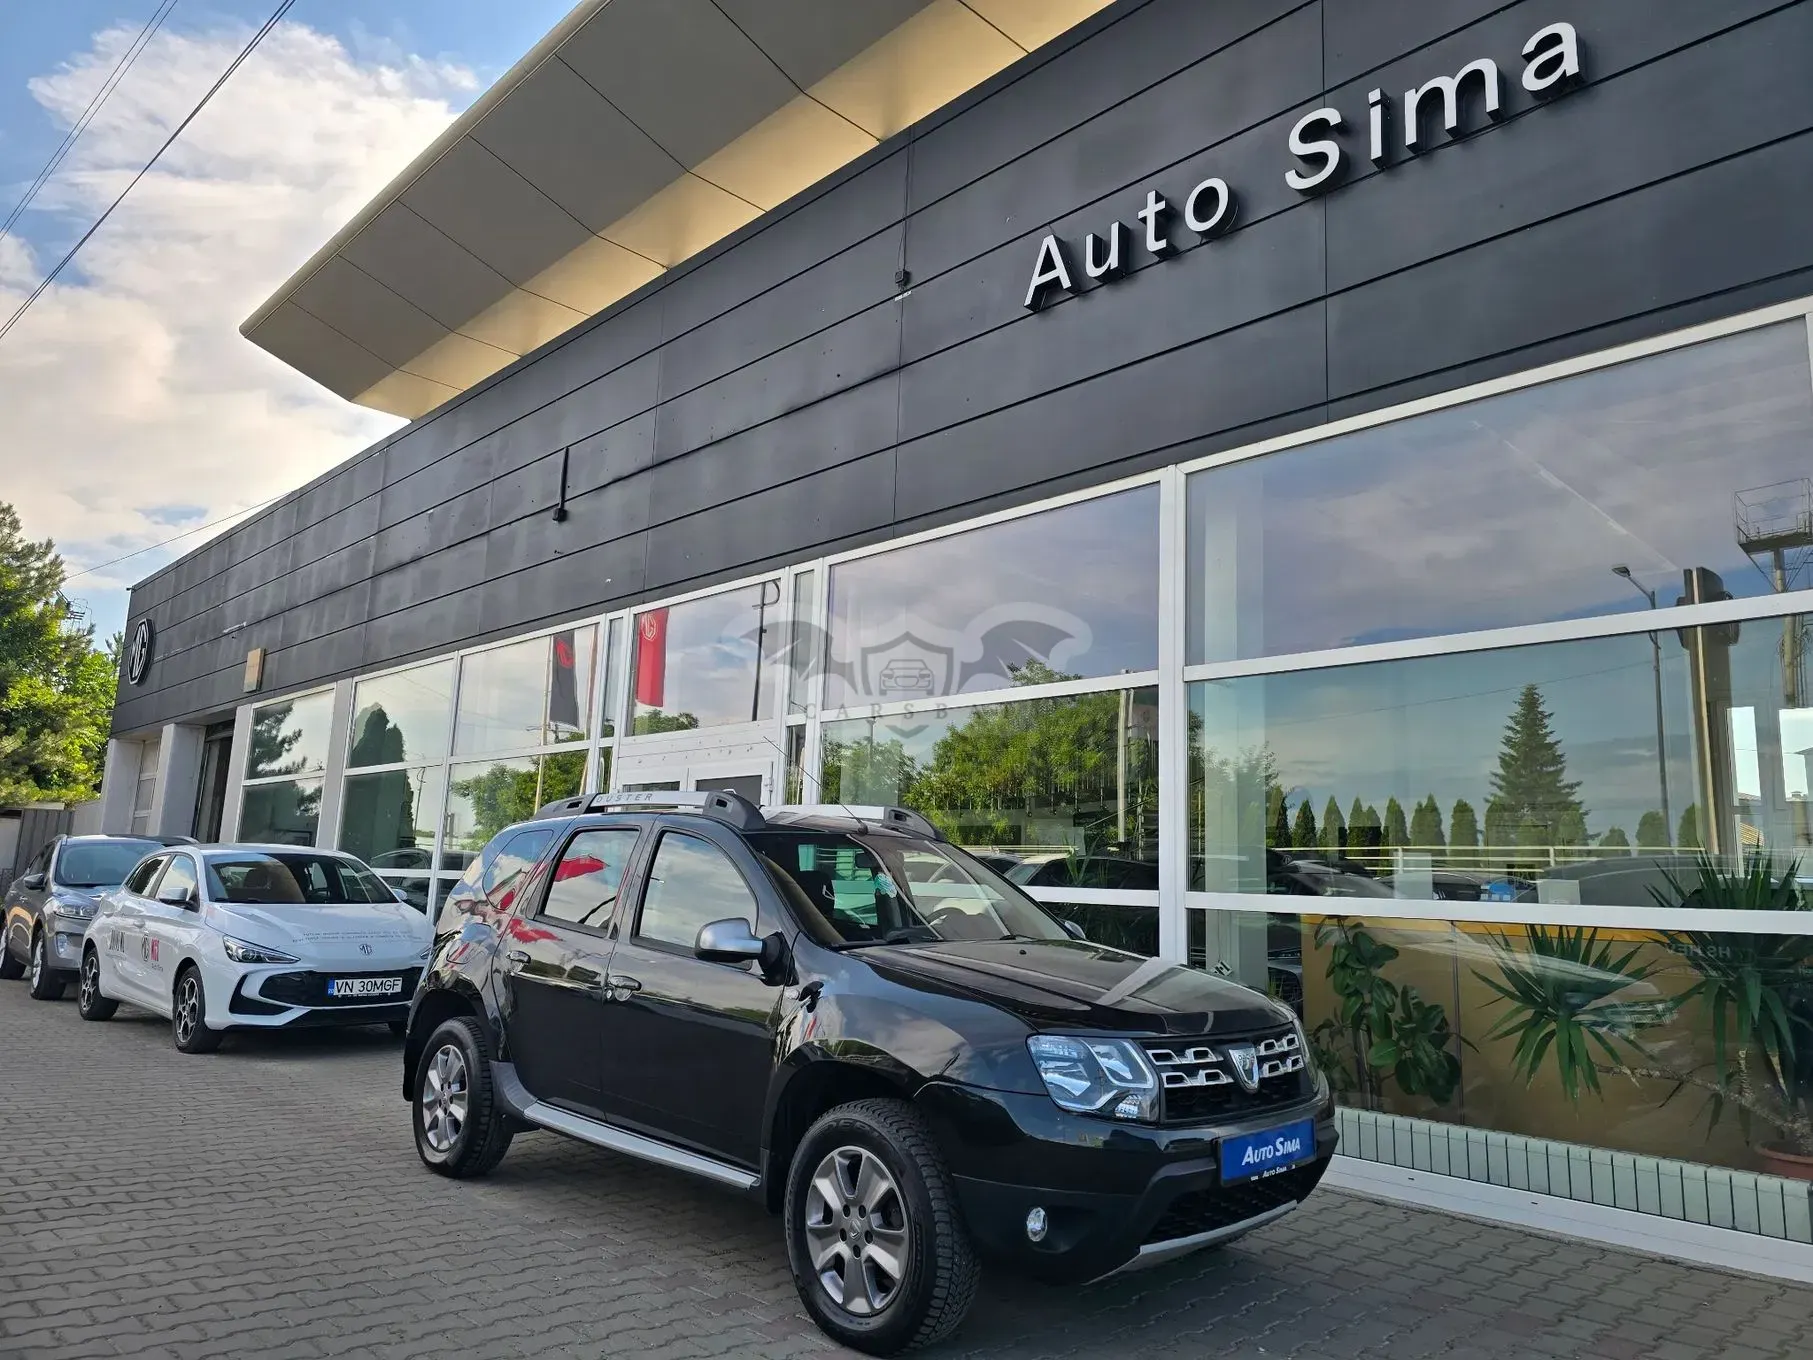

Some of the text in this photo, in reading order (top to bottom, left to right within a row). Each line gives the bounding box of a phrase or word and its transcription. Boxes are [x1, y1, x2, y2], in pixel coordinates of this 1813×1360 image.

[1024, 21, 1581, 308] Auto Sima
[596, 793, 653, 803] DUSTER
[336, 978, 402, 994] VN 30MGF
[1241, 1137, 1301, 1166] AUTO SIMA
